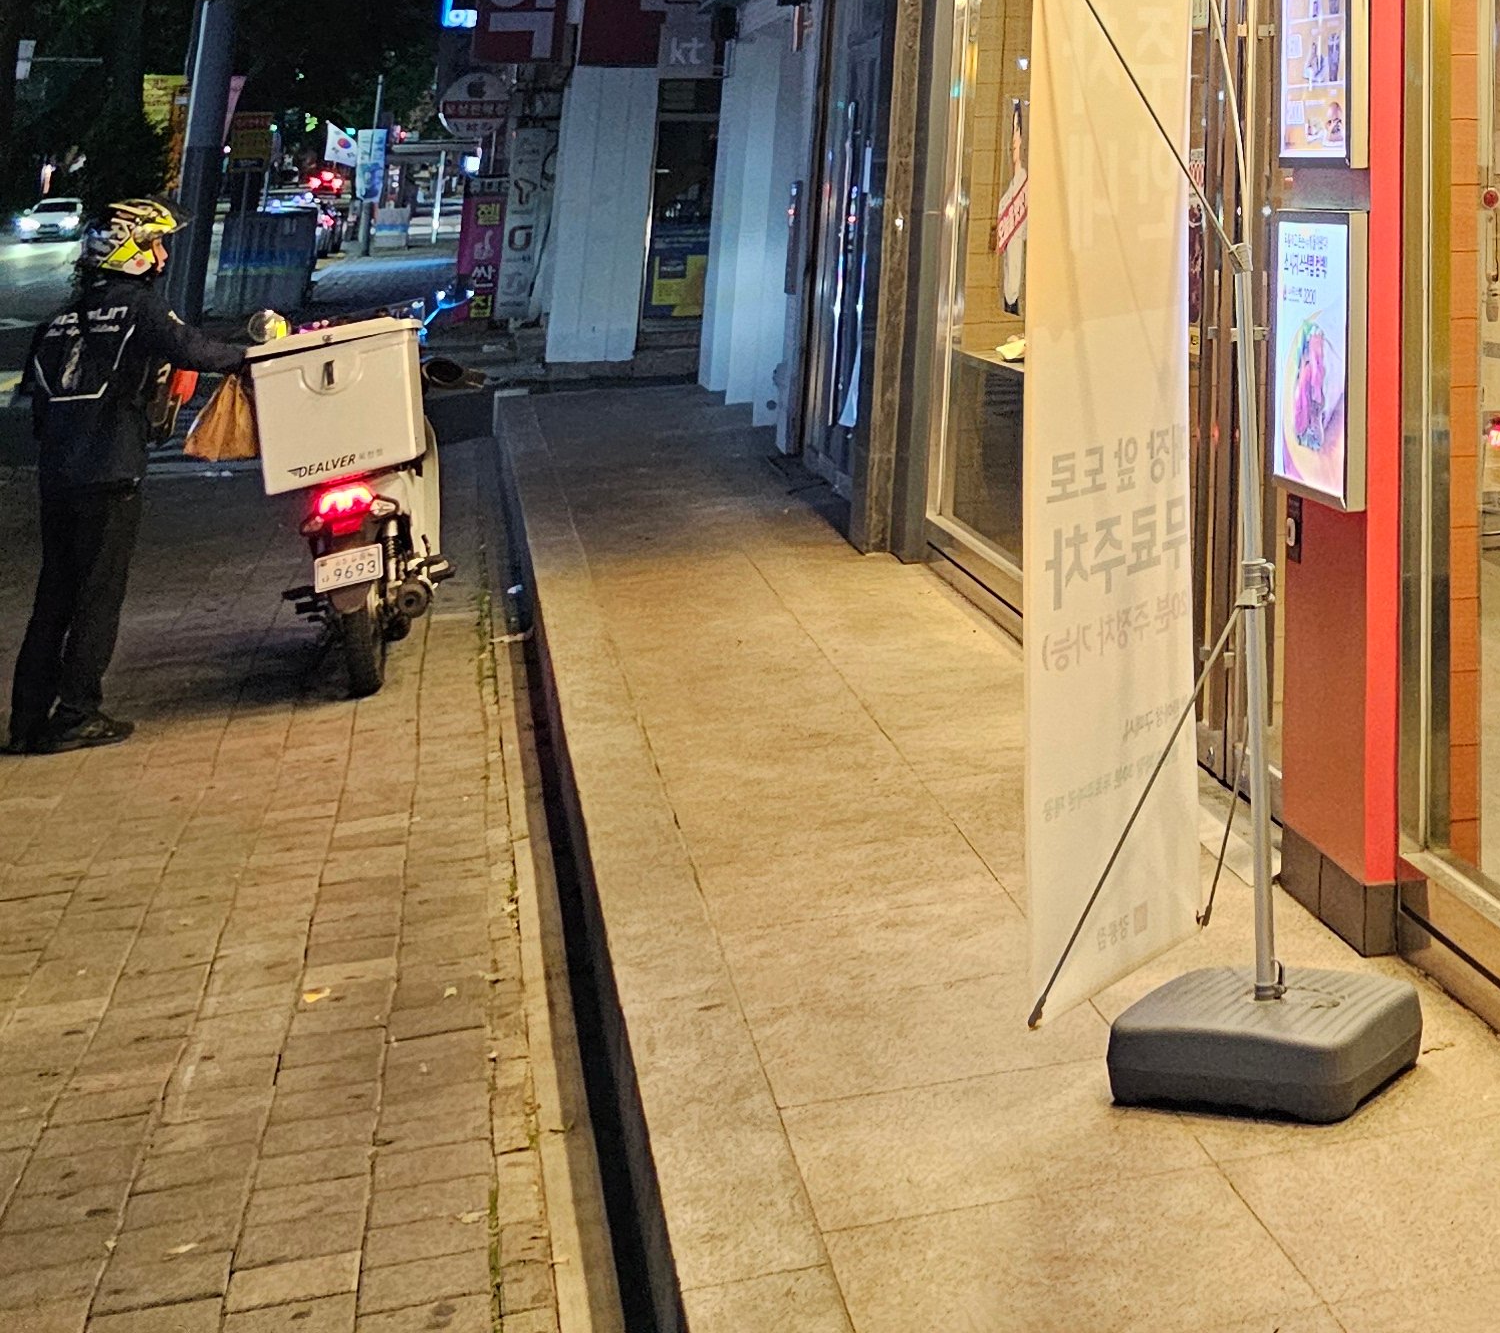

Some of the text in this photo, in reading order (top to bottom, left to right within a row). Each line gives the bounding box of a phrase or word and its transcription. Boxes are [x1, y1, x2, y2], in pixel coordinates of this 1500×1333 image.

[670, 36, 705, 65] kt
[297, 453, 357, 478] DEALVER
[334, 559, 376, 582] 9693
